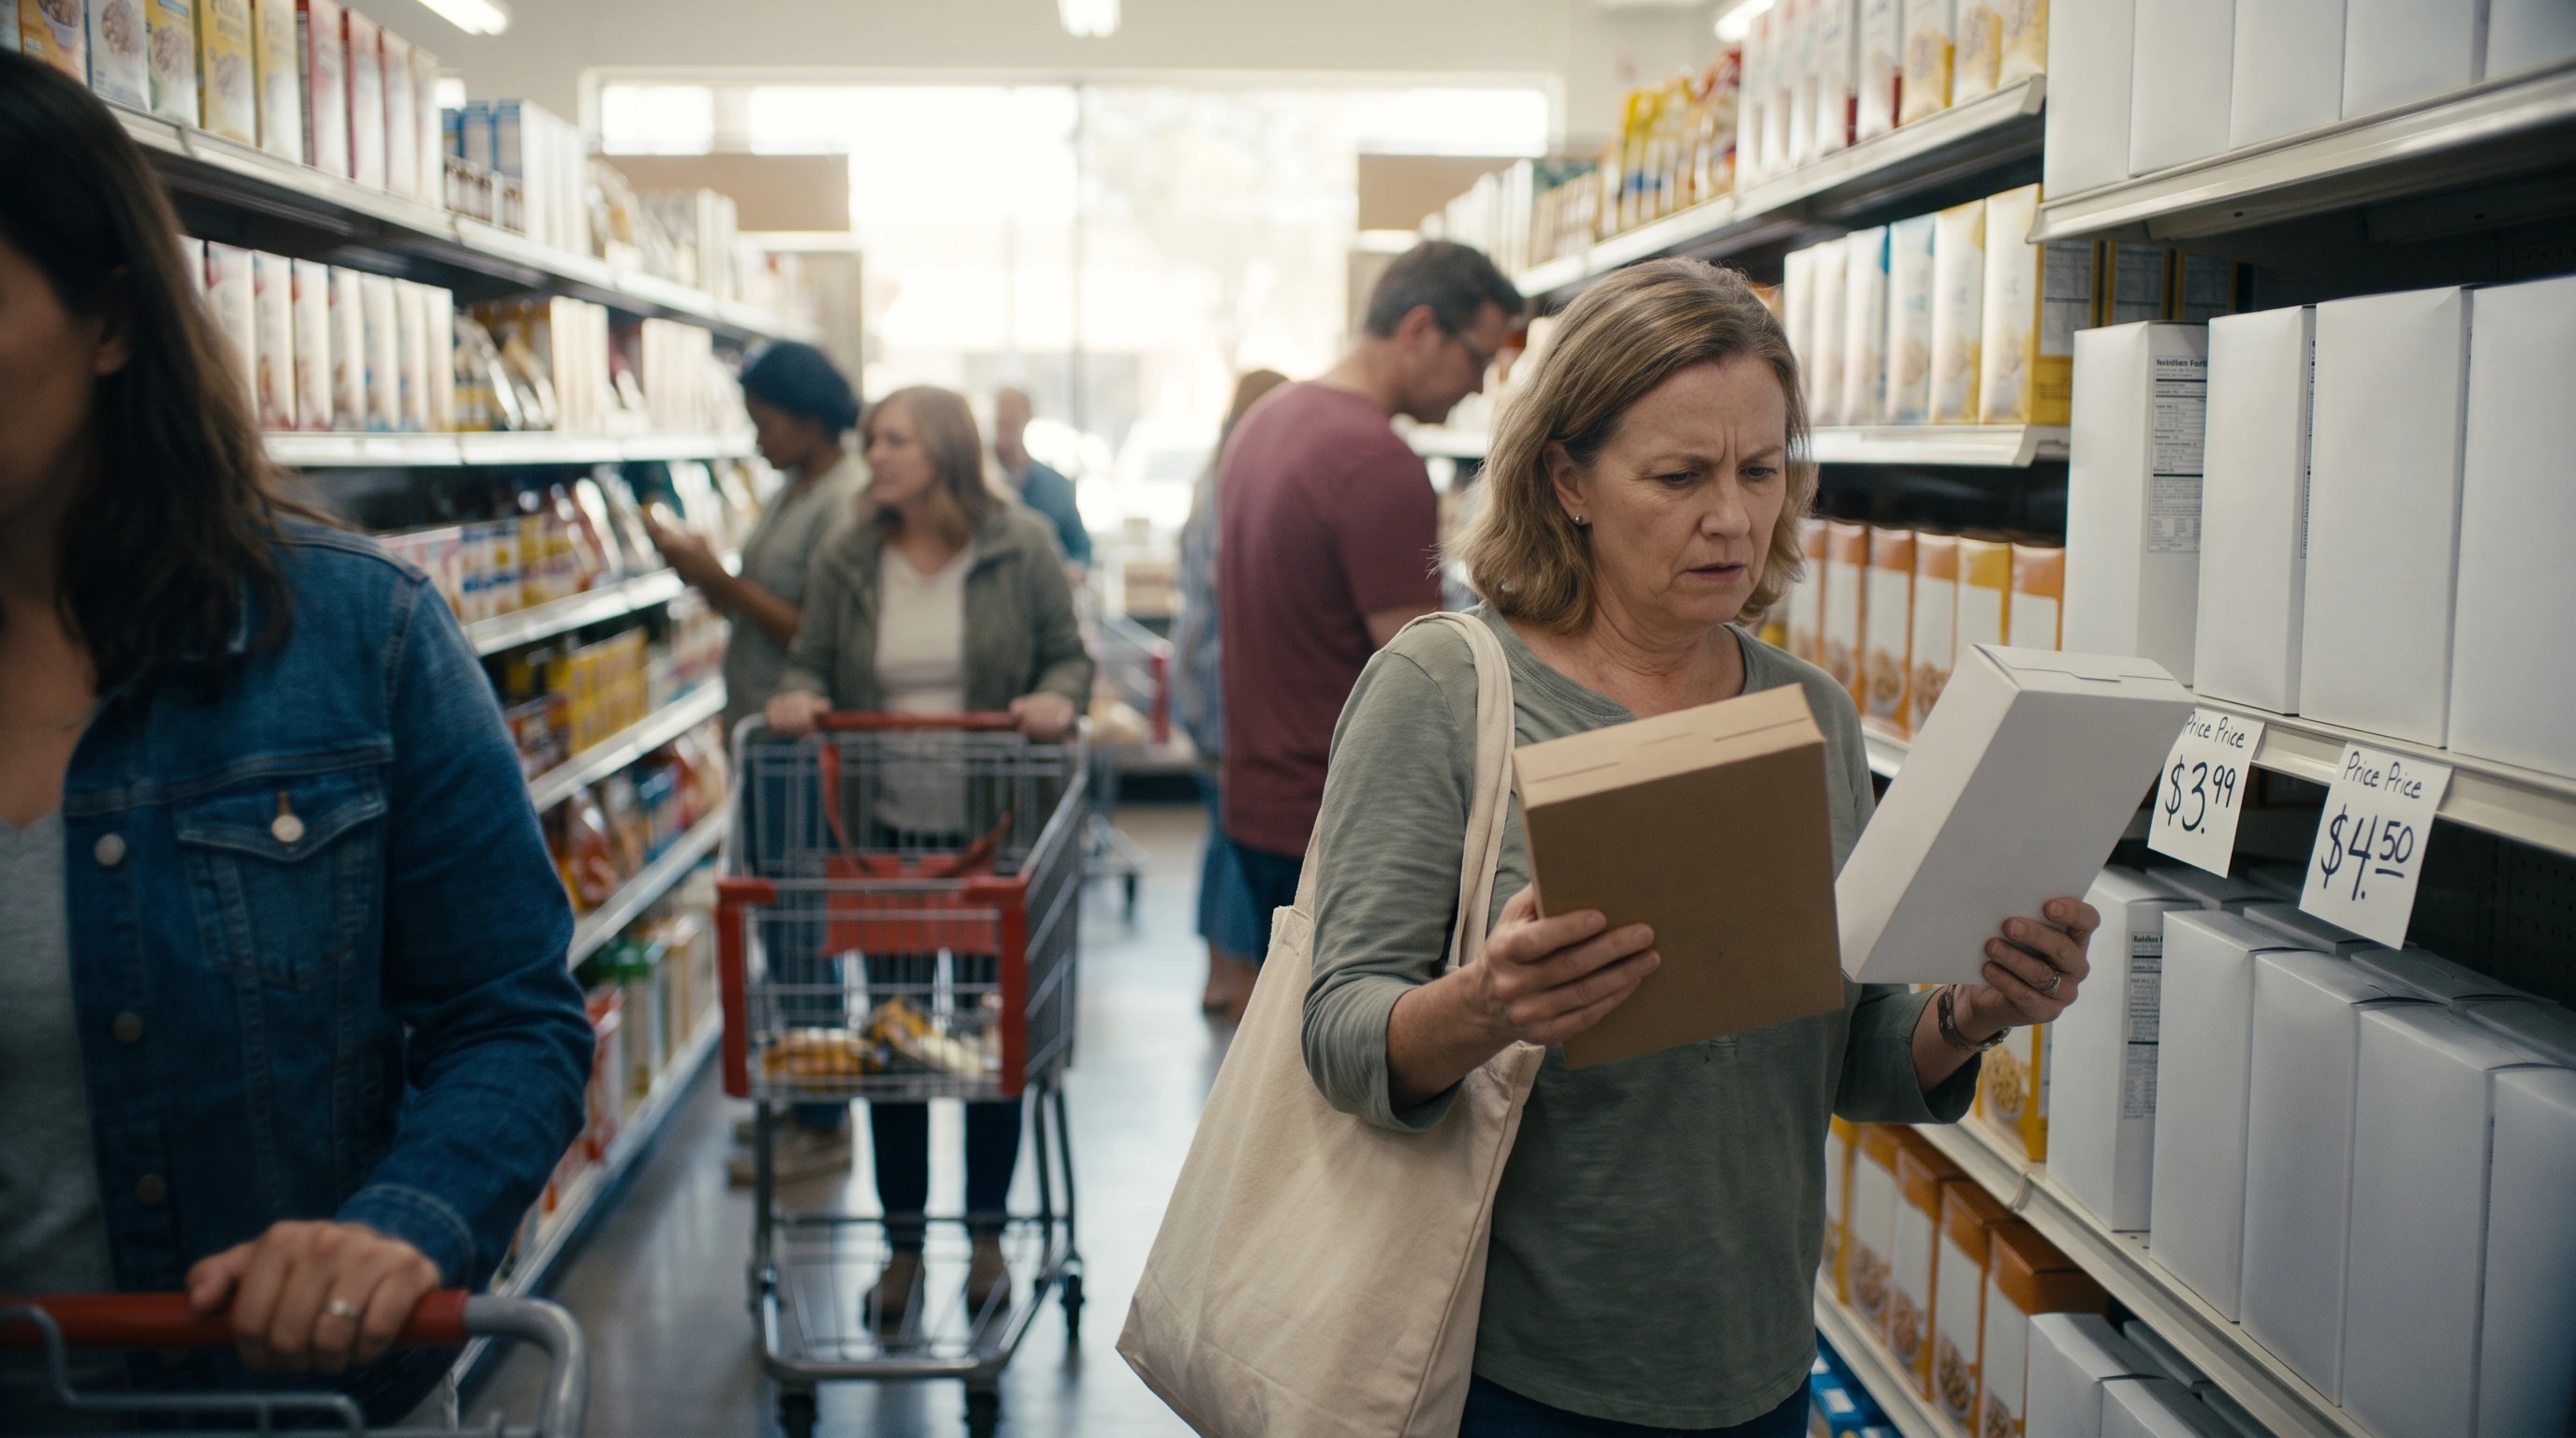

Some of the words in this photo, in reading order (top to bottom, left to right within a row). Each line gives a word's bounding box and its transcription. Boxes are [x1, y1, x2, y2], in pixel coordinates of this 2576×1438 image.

[2183, 712, 2211, 739] Price
[2215, 716, 2245, 748] Price
[2344, 751, 2379, 787] Price
[2384, 761, 2422, 799] Price
